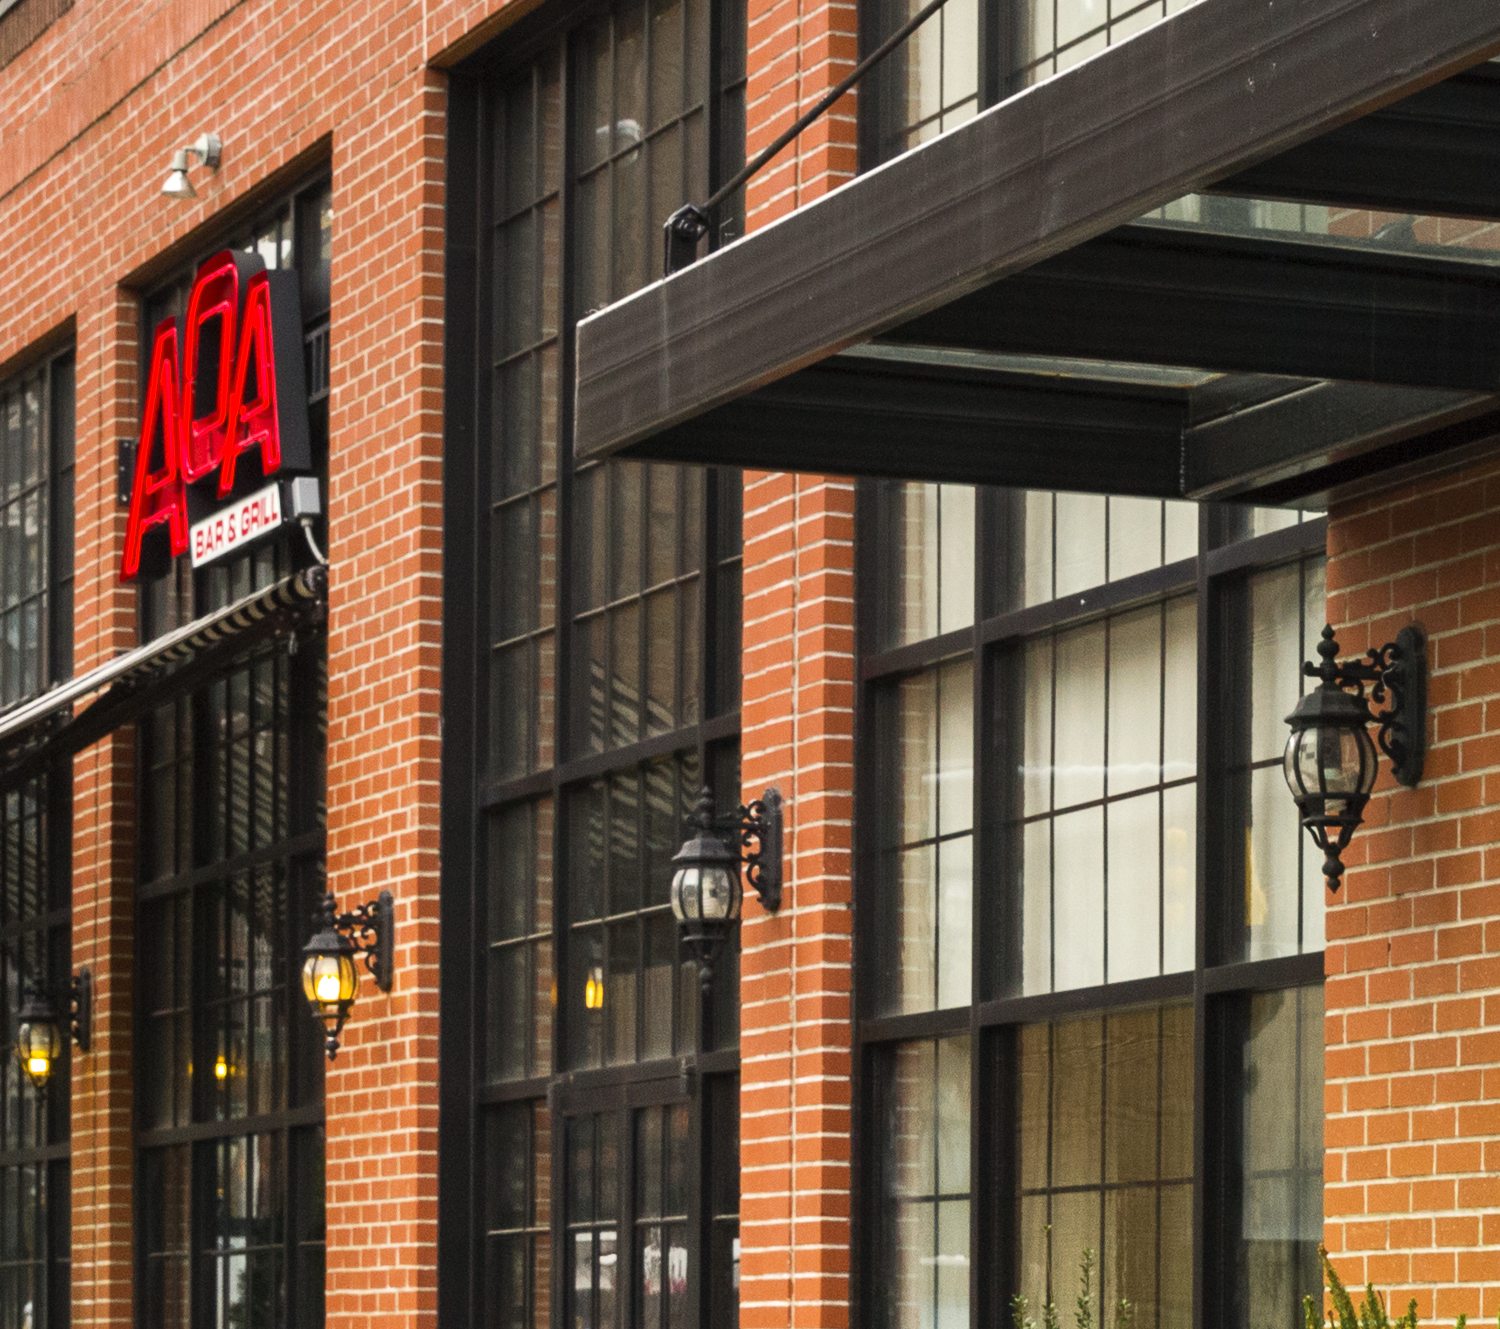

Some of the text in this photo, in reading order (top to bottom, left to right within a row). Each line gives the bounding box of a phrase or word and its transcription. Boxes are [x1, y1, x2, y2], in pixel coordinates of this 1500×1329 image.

[118, 248, 283, 584] AOA
[195, 491, 279, 559] BAR & GRILL
